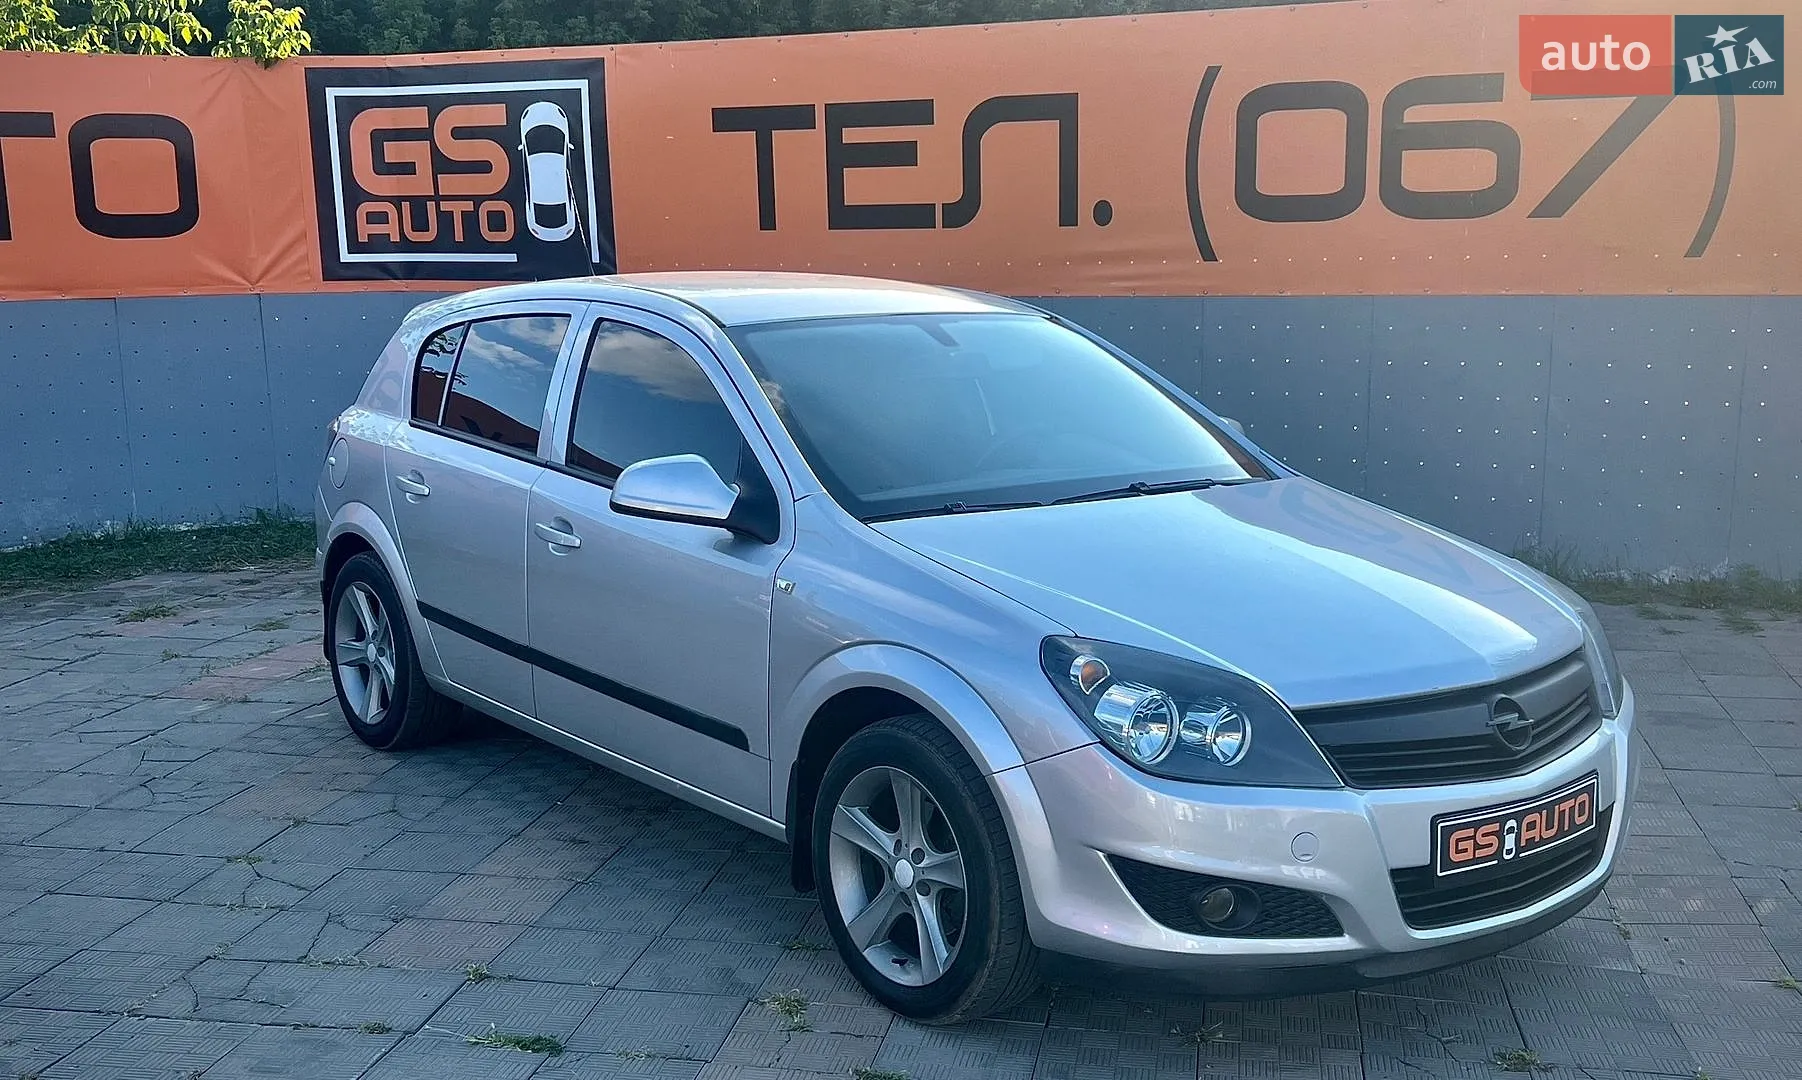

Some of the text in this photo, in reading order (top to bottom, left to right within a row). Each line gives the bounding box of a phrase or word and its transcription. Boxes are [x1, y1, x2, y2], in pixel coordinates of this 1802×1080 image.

[348, 103, 511, 197] GS
[711, 64, 1737, 262] ТЕЛ. (067)
[356, 199, 517, 244] AUTO
[1449, 792, 1591, 863] GS AUTO
